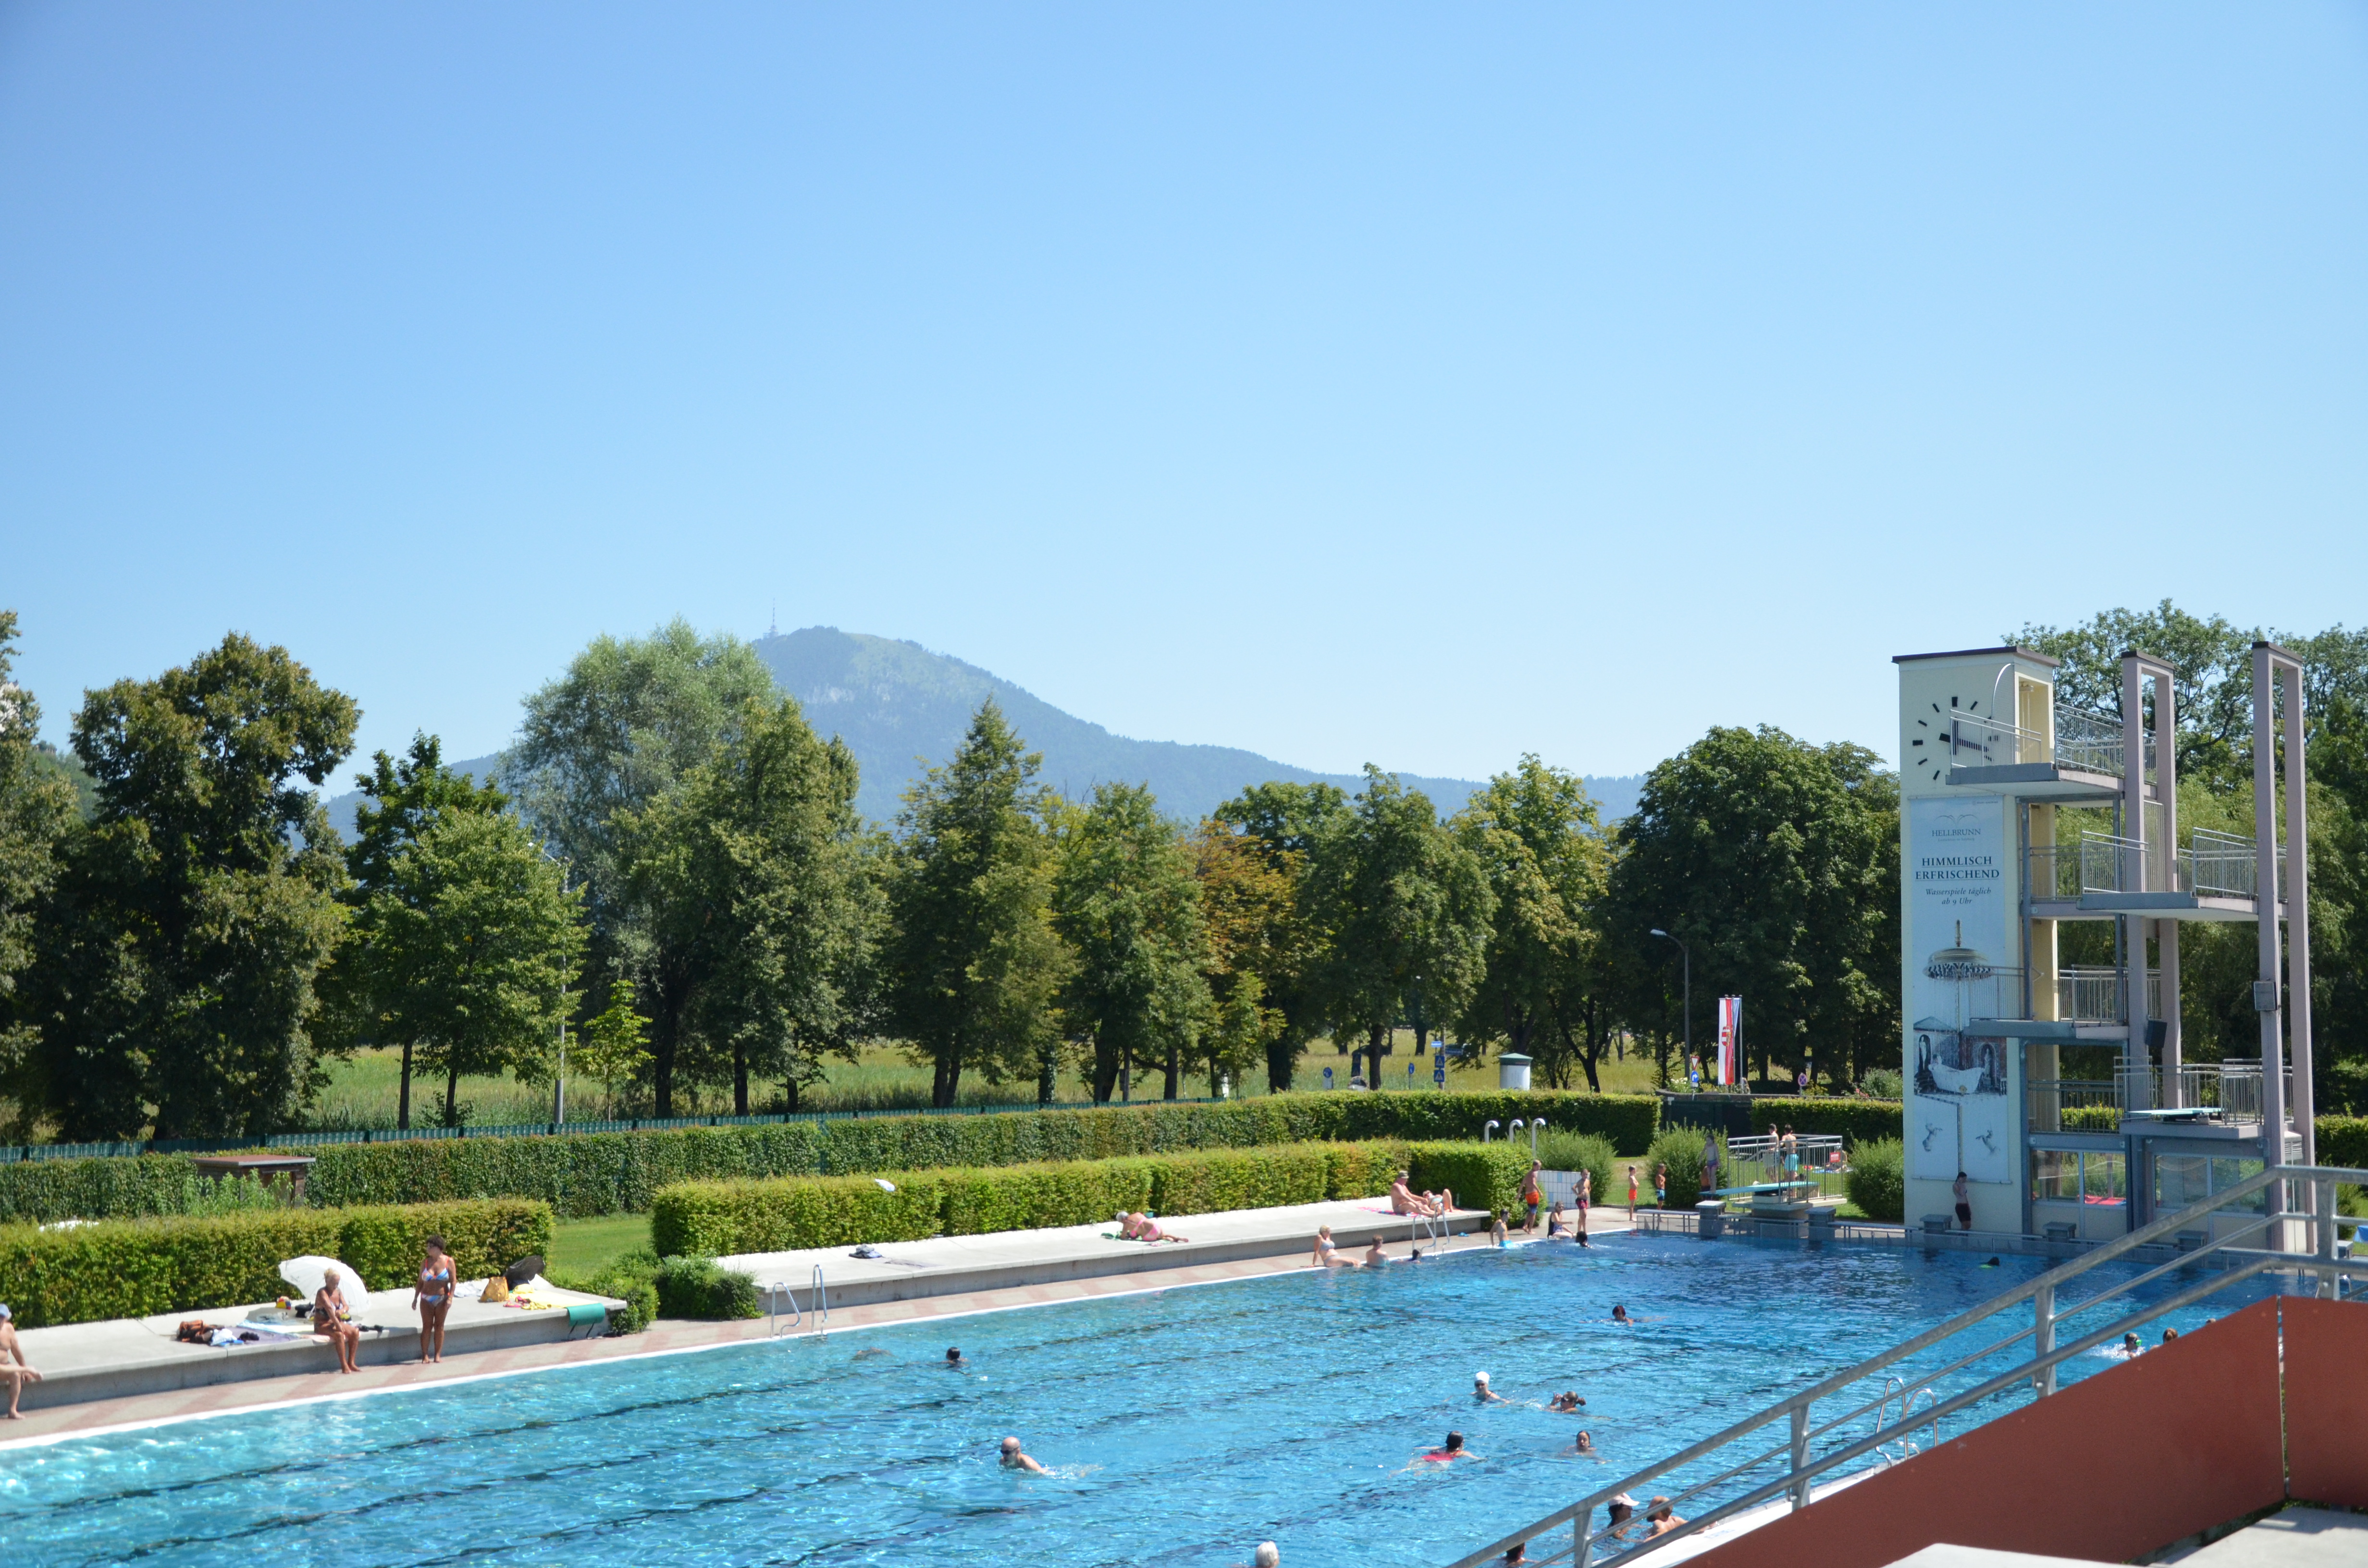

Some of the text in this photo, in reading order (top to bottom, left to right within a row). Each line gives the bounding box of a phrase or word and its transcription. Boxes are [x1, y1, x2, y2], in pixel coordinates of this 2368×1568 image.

[1922, 856, 1992, 866] HIMMLISCH
[1915, 869, 1999, 880] ERFRISCHEND
[1926, 887, 1991, 896] Wasserspiele täglich
